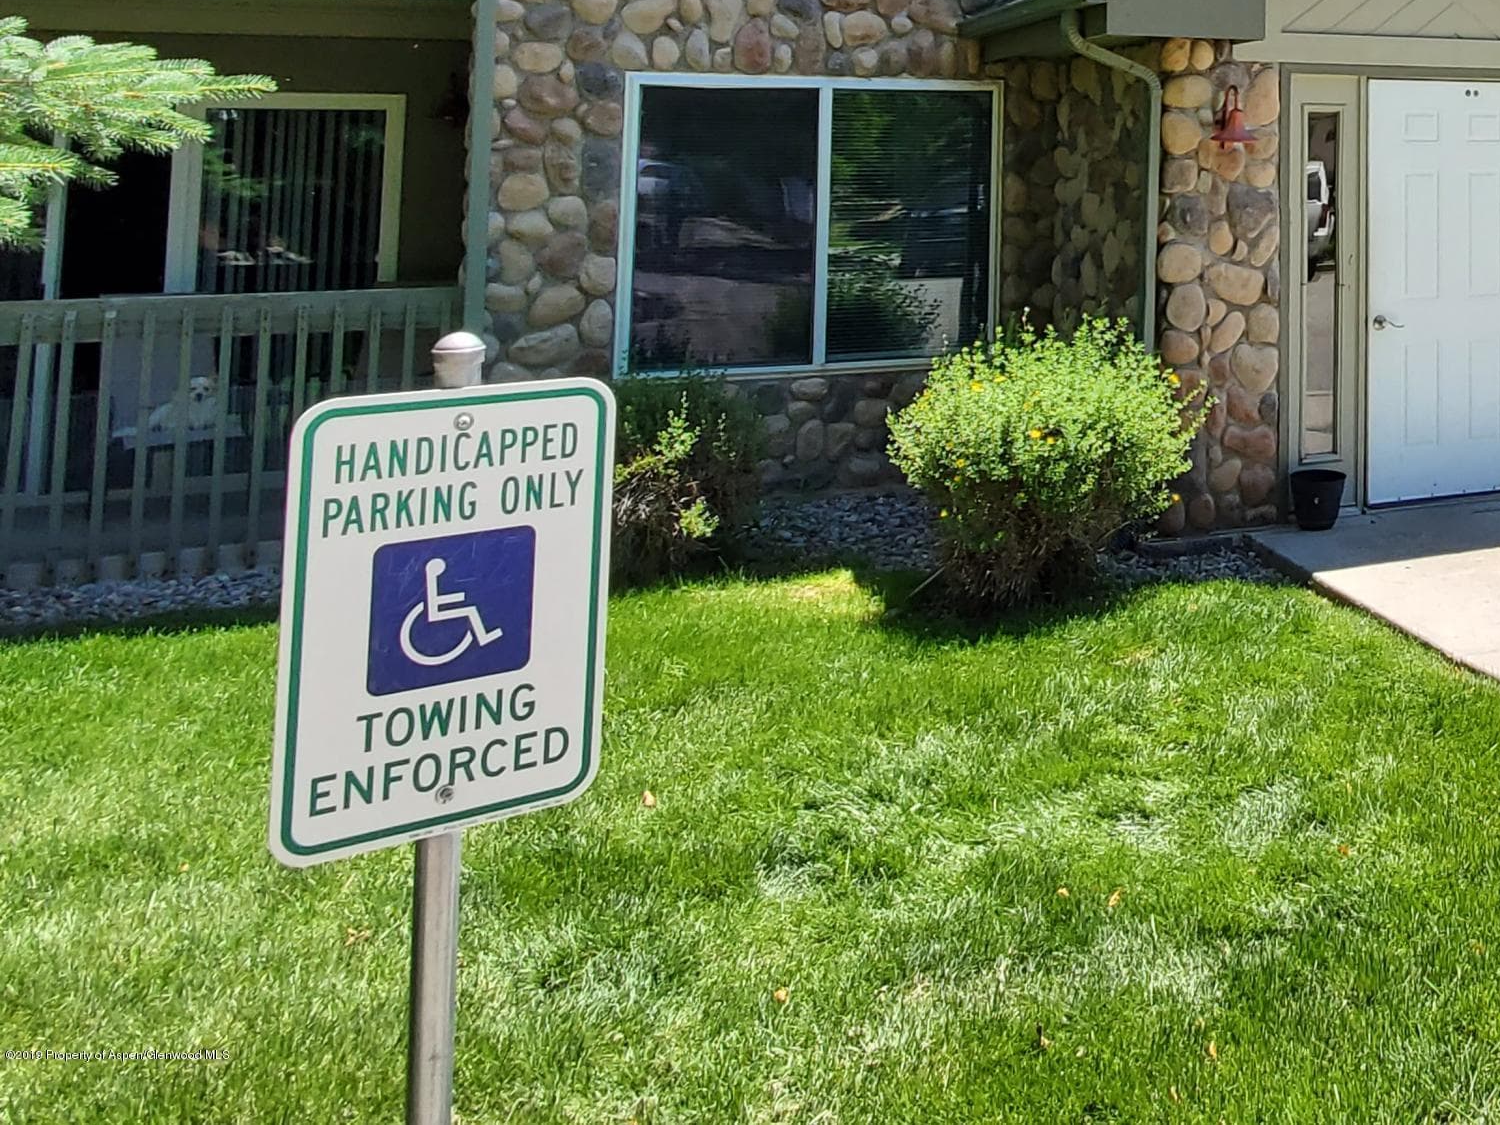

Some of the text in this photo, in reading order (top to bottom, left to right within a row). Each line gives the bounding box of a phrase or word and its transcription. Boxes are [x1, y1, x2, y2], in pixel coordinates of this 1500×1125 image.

[334, 421, 579, 485] HANDICAPPED
[322, 468, 585, 538] PARKING ONLY
[356, 683, 536, 753] TOWING
[308, 725, 570, 818] ENFORCED
